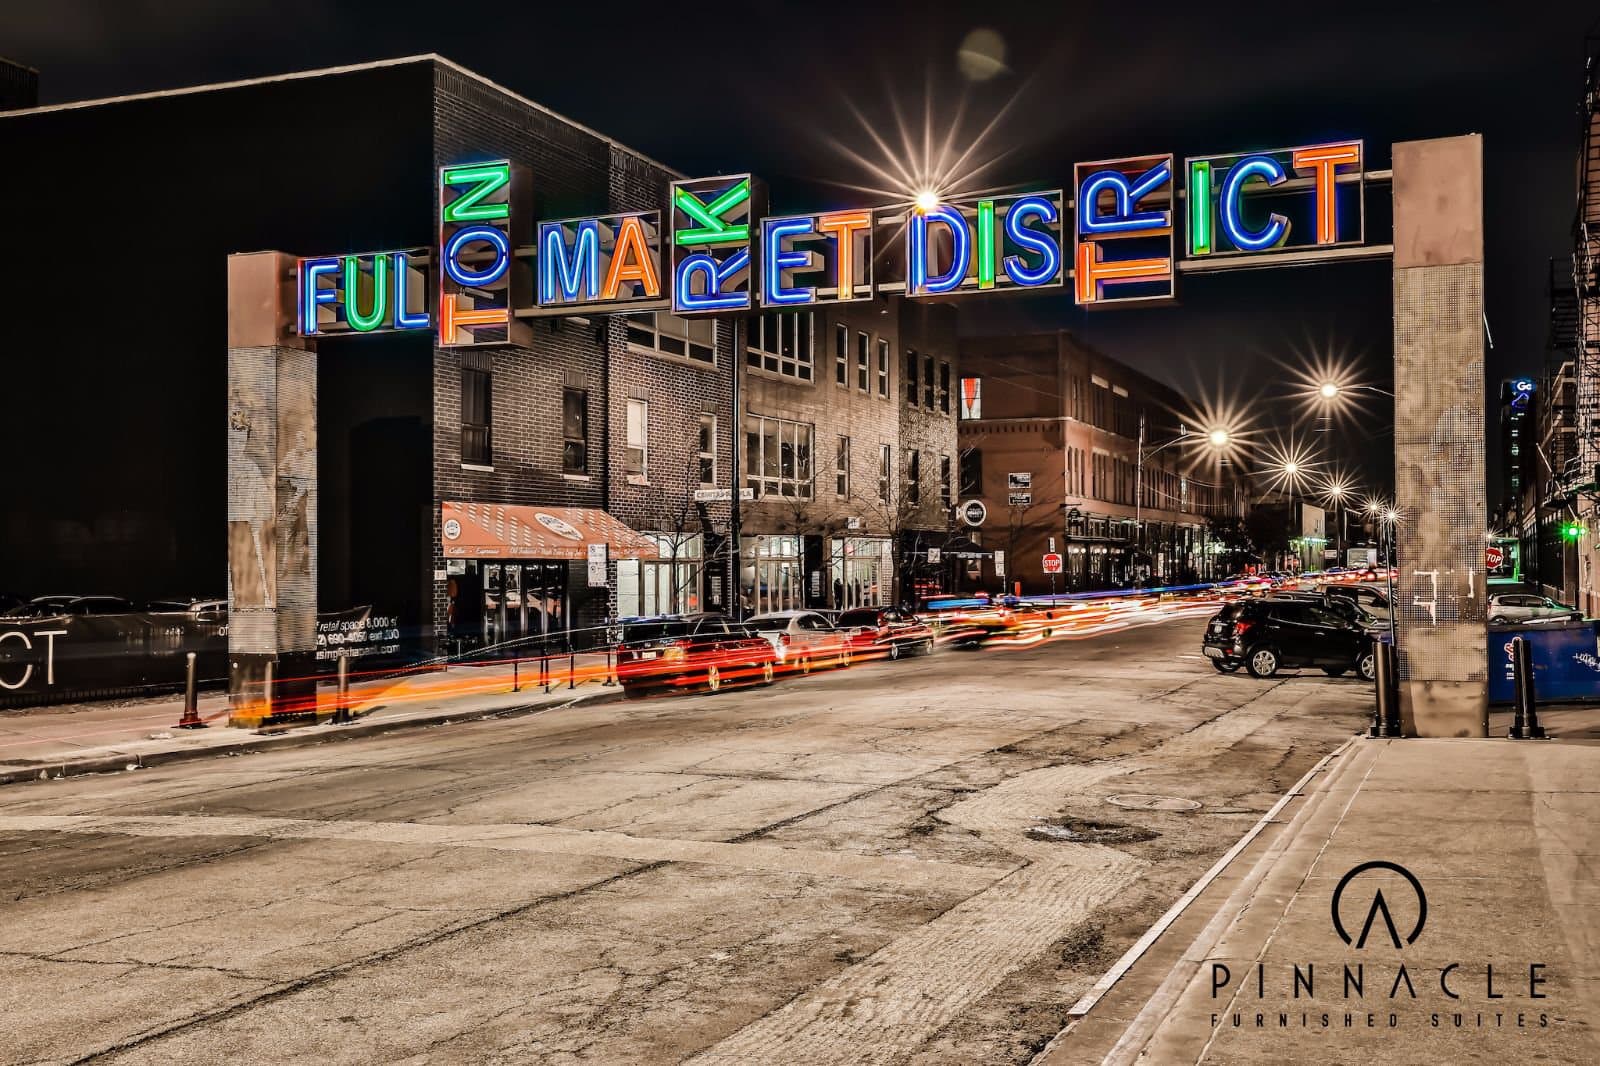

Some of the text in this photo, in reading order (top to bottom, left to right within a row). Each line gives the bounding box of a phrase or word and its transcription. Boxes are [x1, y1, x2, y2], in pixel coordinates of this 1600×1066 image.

[538, 177, 872, 308] MARKET
[906, 144, 1363, 303] DISTRICT
[1044, 559, 1060, 567] STOP
[1486, 553, 1501, 563] TOP
[340, 621, 364, 633] space
